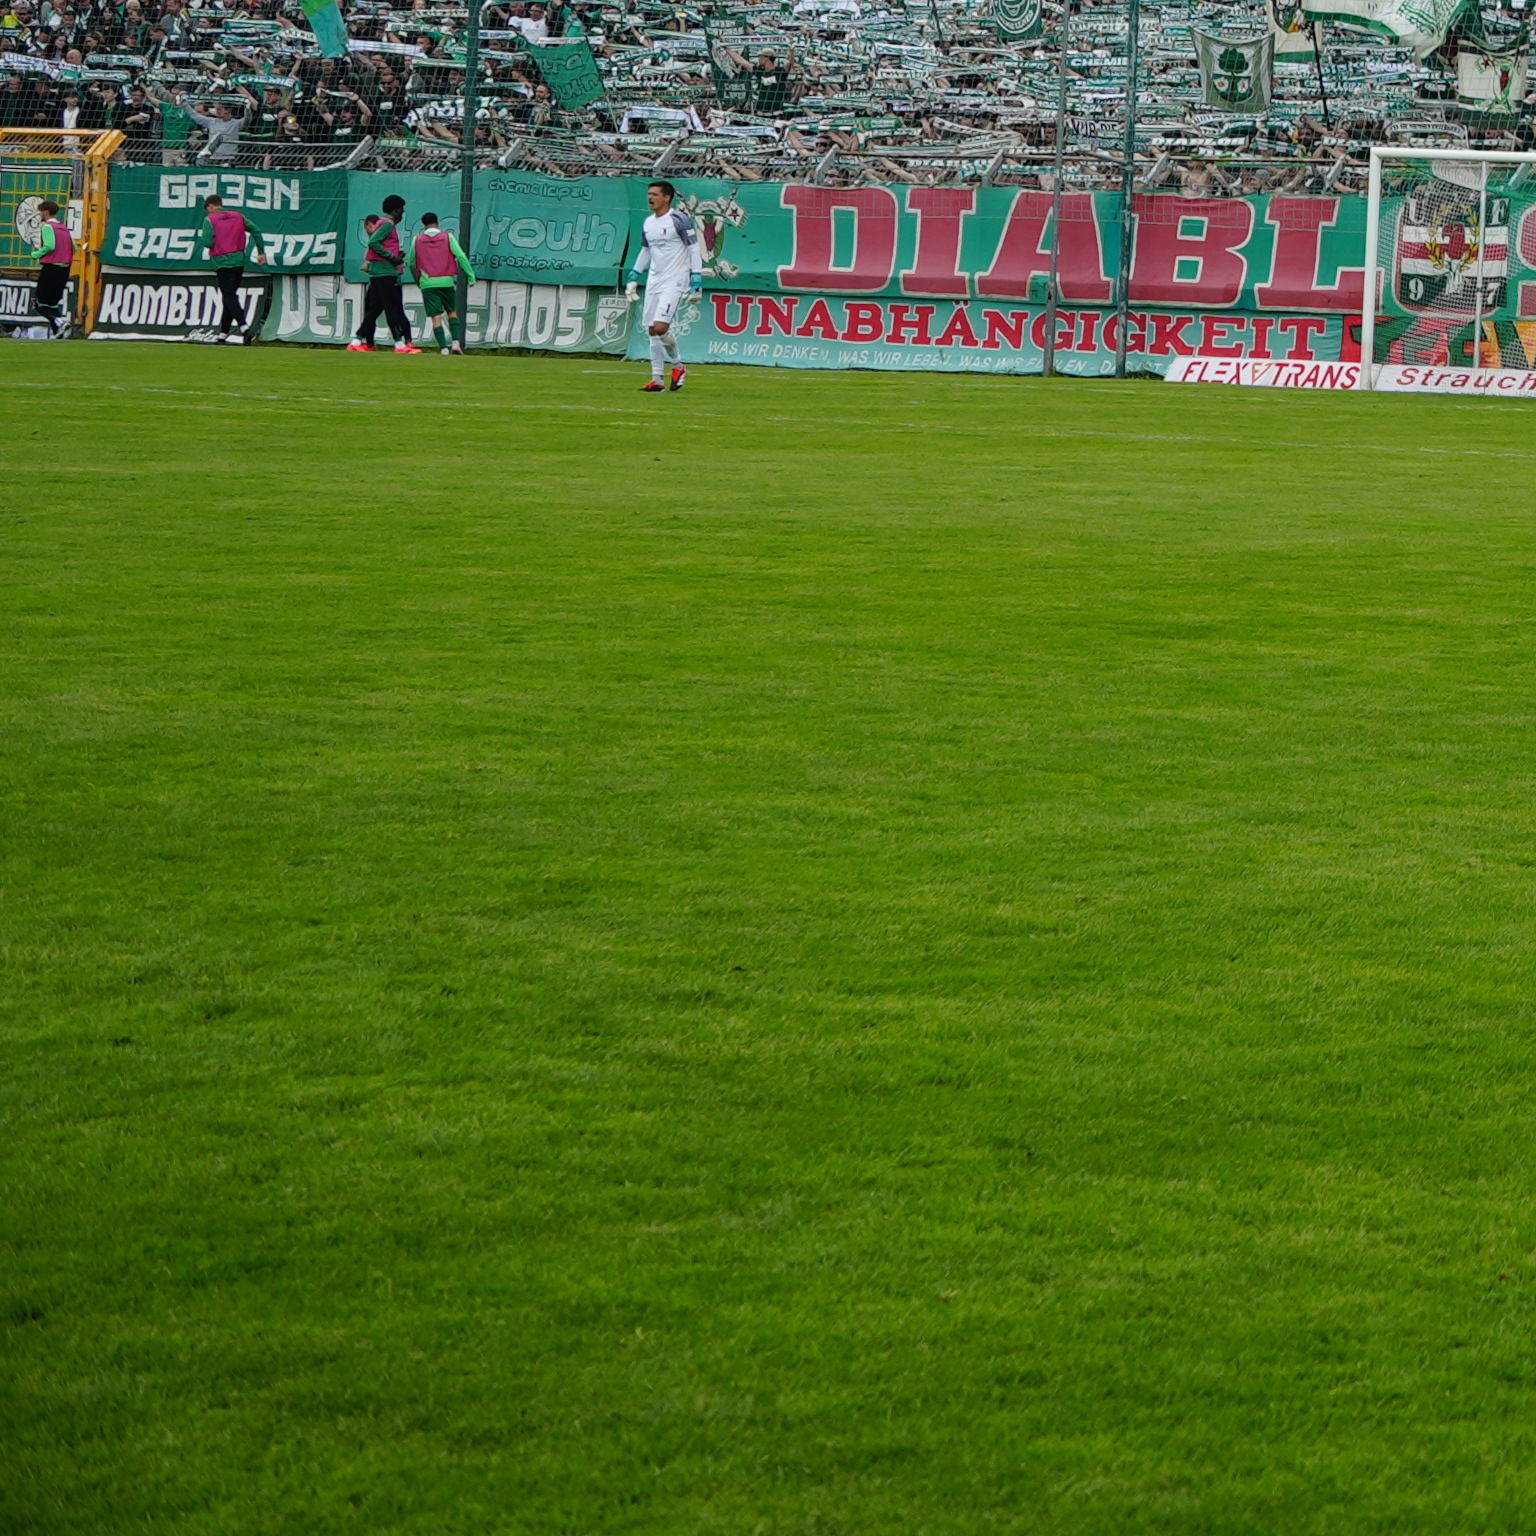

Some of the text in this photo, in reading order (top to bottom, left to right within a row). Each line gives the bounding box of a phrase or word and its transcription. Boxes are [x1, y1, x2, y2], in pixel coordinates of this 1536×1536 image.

[238, 73, 296, 88] CHEMIE
[710, 293, 1327, 361] UNABHÄNGIGKEIT
[708, 340, 740, 356] WAS
[742, 342, 770, 358] WIR
[837, 348, 869, 366] WAS
[872, 350, 902, 367] WIR
